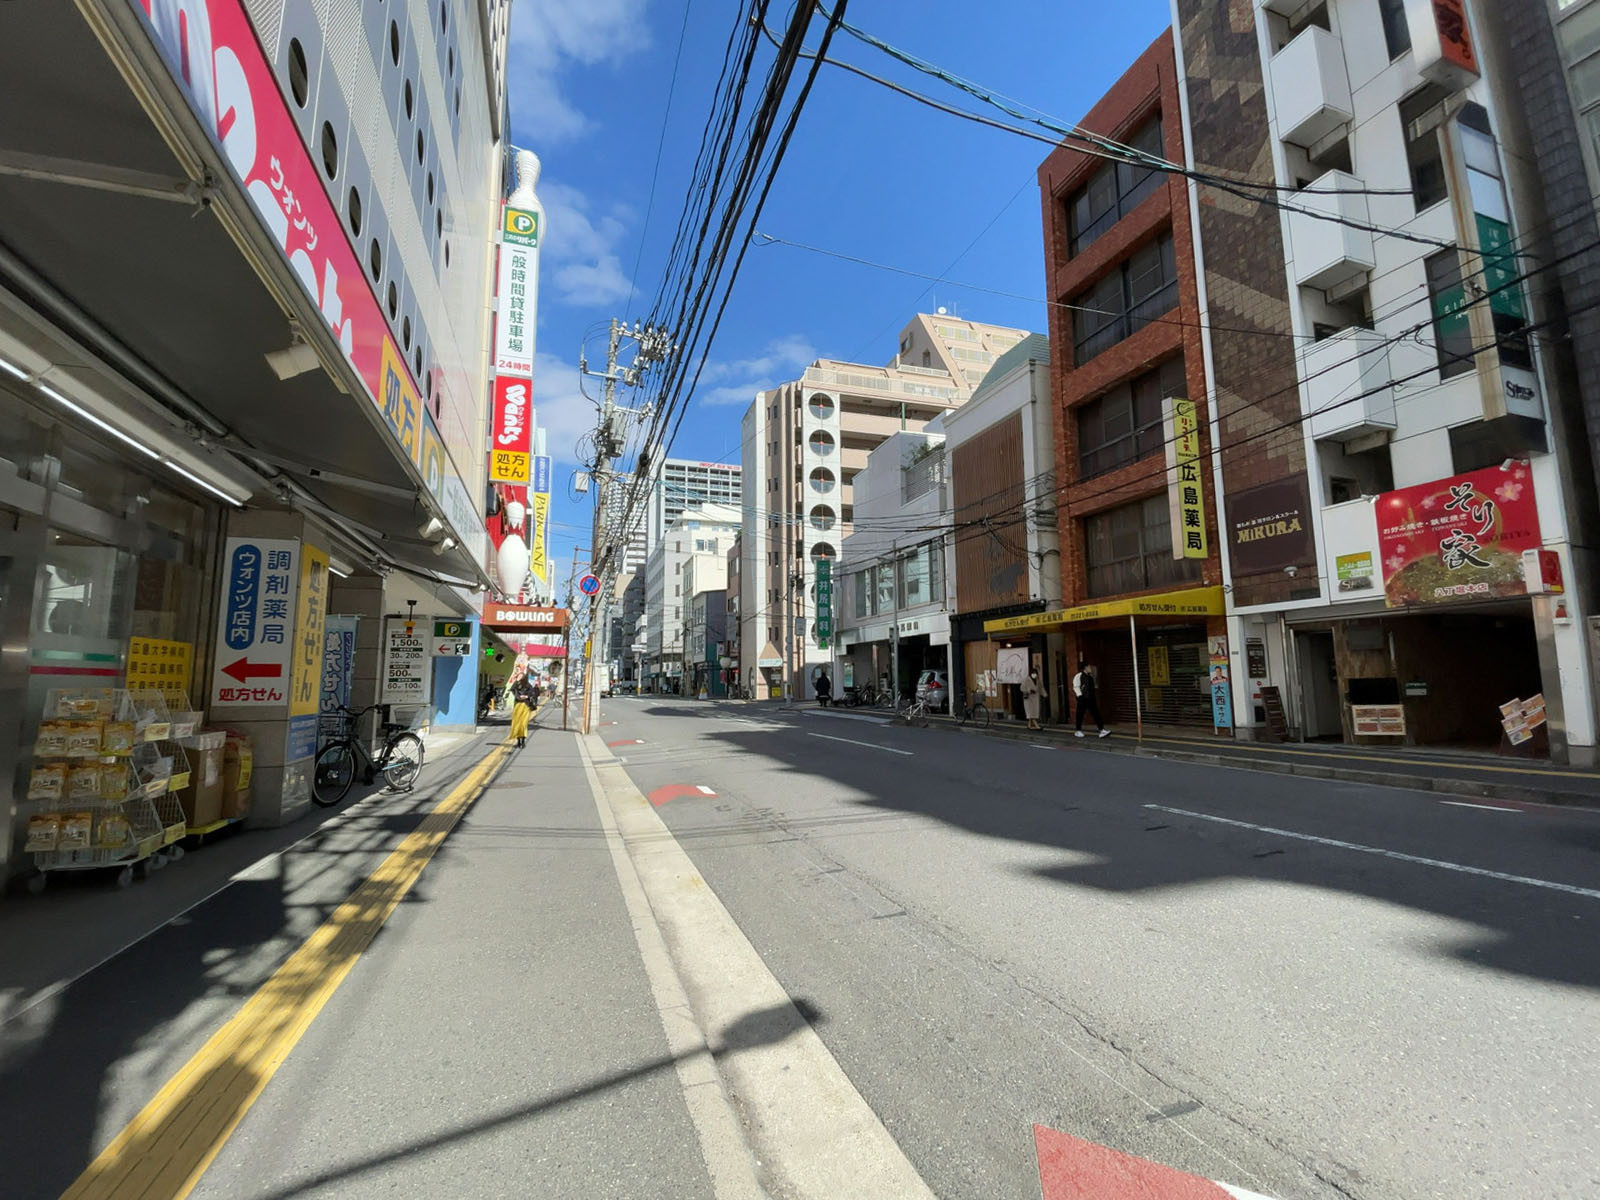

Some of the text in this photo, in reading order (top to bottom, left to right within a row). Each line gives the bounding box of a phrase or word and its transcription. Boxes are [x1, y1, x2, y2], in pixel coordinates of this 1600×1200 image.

[508, 248, 527, 353] 一般時間貸駐車場
[498, 360, 531, 372] 24時間
[498, 384, 526, 445] Wants
[496, 465, 525, 478] せん
[497, 453, 525, 466] 処方
[535, 495, 546, 529] PARK
[1182, 464, 1203, 551] 広島薬局
[260, 550, 291, 644] 調剤薬局
[1434, 582, 1489, 597] 八丁堀本店
[496, 610, 554, 622] BOWLING
[301, 558, 321, 703] 処方せん
[218, 687, 283, 702] 処方せん
